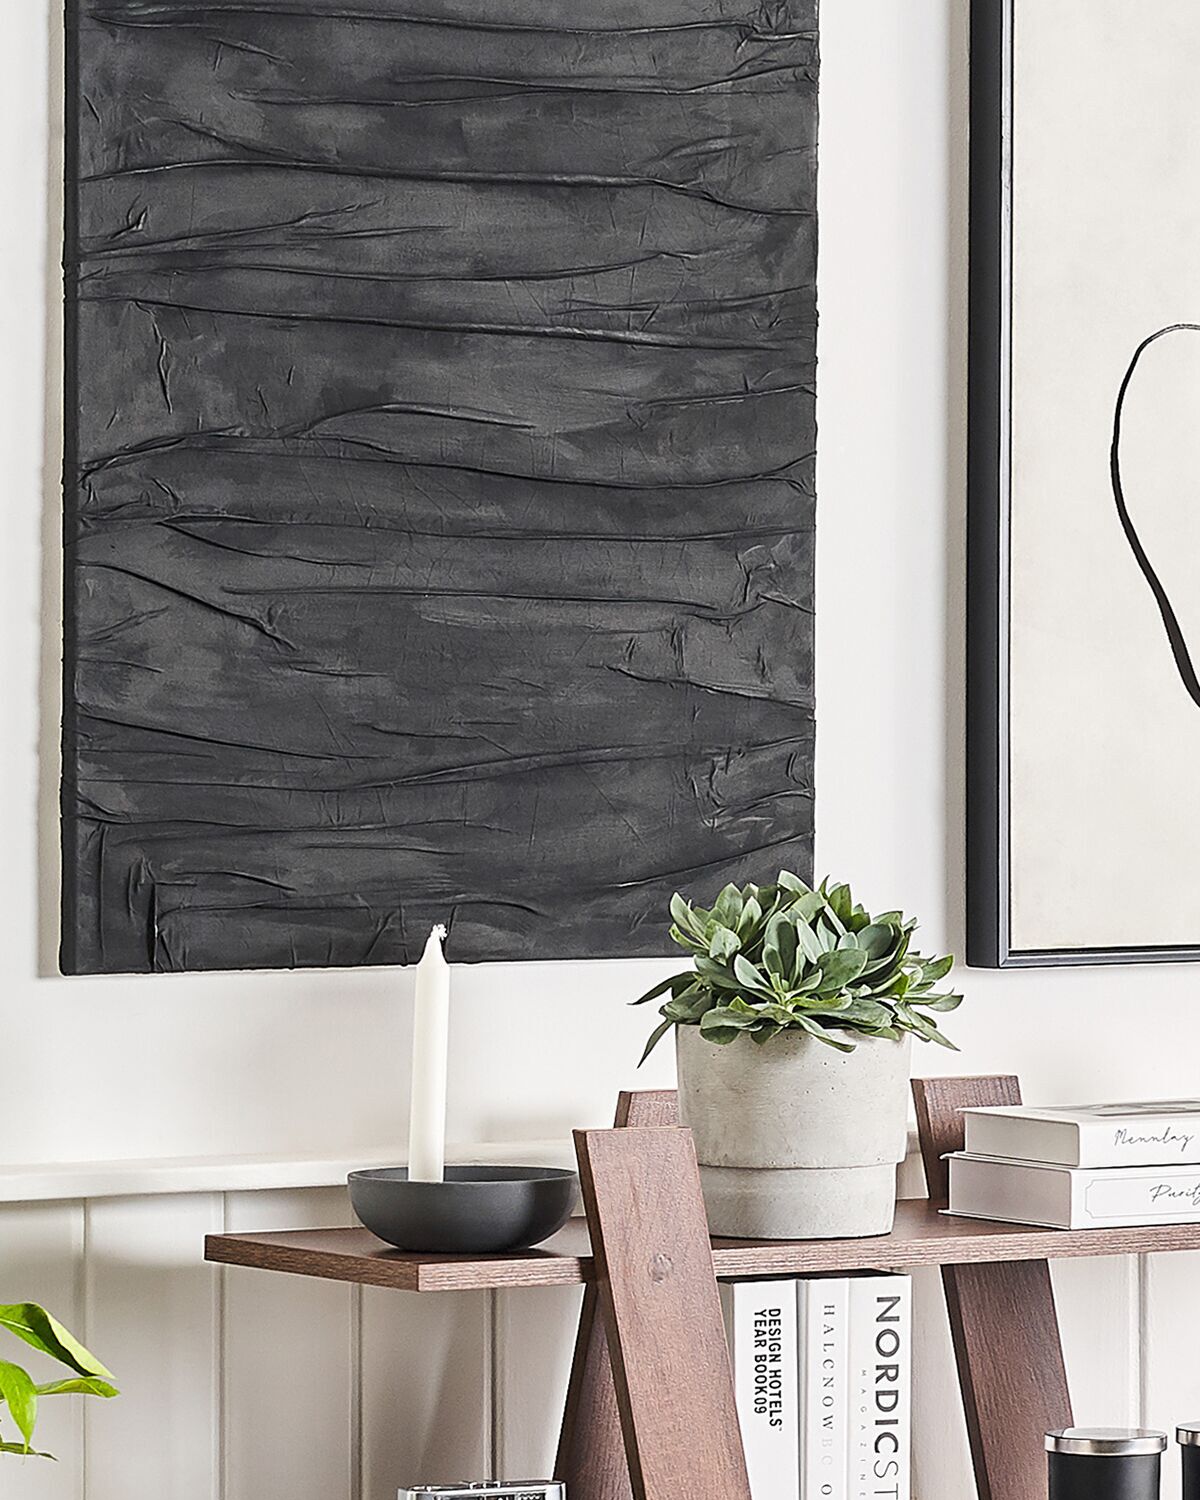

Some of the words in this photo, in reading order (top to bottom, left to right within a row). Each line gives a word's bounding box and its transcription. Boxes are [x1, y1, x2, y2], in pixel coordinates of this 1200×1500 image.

[754, 1309, 767, 1348] YEAR
[768, 1308, 782, 1363] DESIGN
[859, 1369, 867, 1497] MAGAZINE
